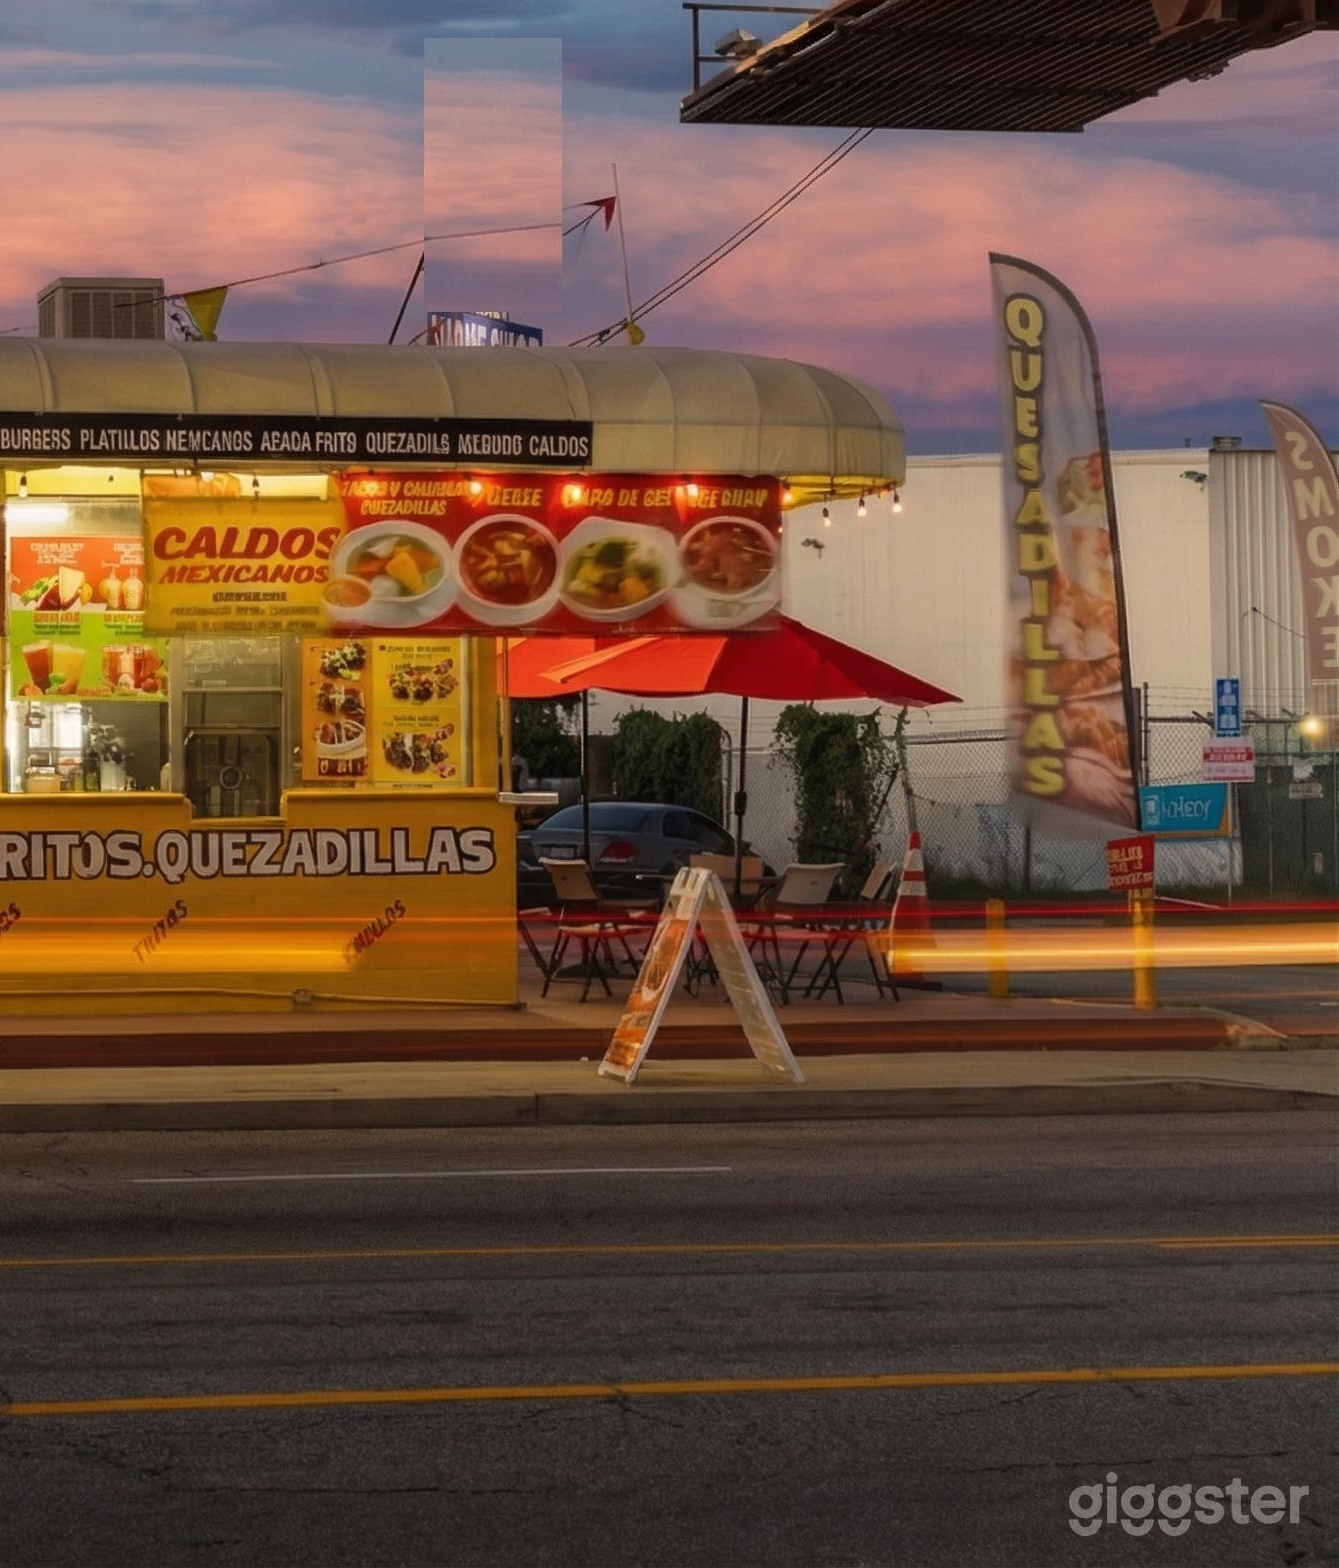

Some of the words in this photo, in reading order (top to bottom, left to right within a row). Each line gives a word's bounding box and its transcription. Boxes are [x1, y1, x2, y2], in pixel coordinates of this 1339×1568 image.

[530, 435, 589, 457] CALDOS
[153, 526, 342, 560] CALDOS
[1005, 296, 1065, 796] QUESADILLAS
[159, 564, 330, 585] MEXICANOS
